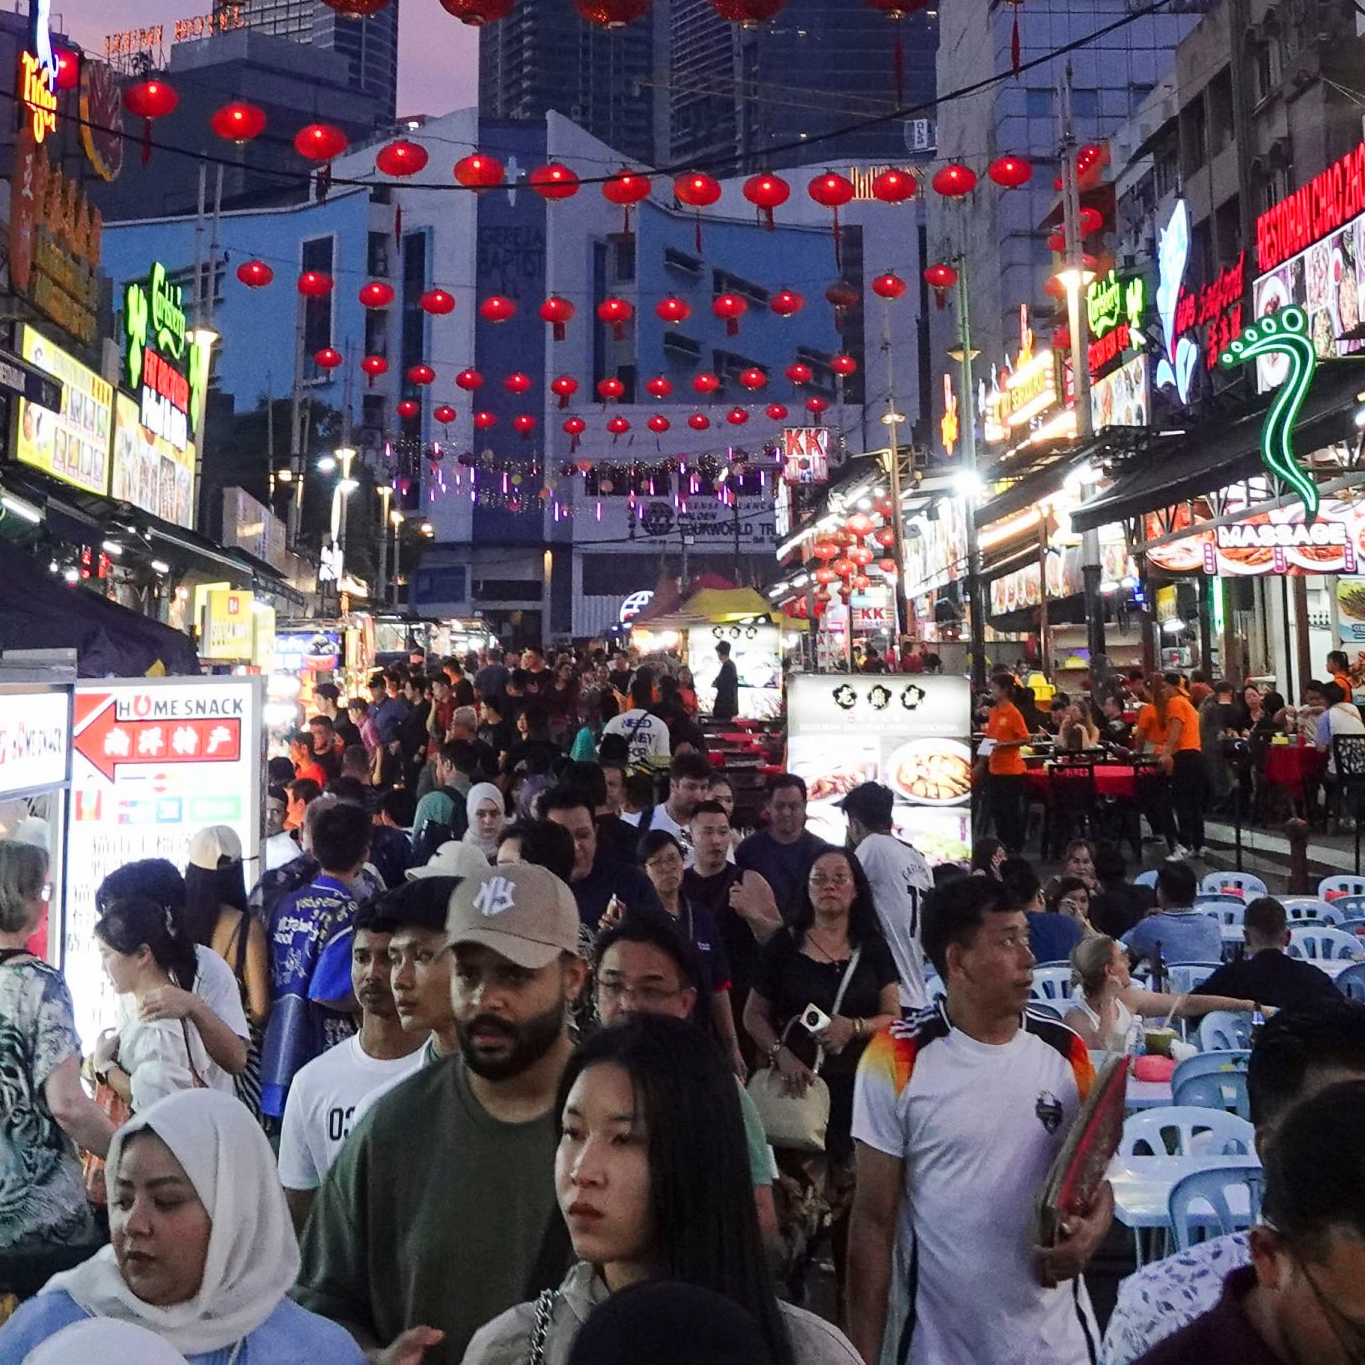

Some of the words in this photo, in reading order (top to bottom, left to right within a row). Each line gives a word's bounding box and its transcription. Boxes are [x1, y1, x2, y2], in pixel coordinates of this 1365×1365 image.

[174, 5, 245, 42] HOTEL
[21, 49, 59, 145] Tiger
[151, 261, 187, 352] Carlsberg
[1087, 269, 1121, 331] Carlsberg
[785, 428, 825, 456] KK
[1217, 522, 1346, 548] MASSAGE
[860, 607, 885, 620] KK
[118, 695, 179, 718] HOME
[184, 698, 244, 715] SNACK
[104, 725, 232, 758] 南洋特产
